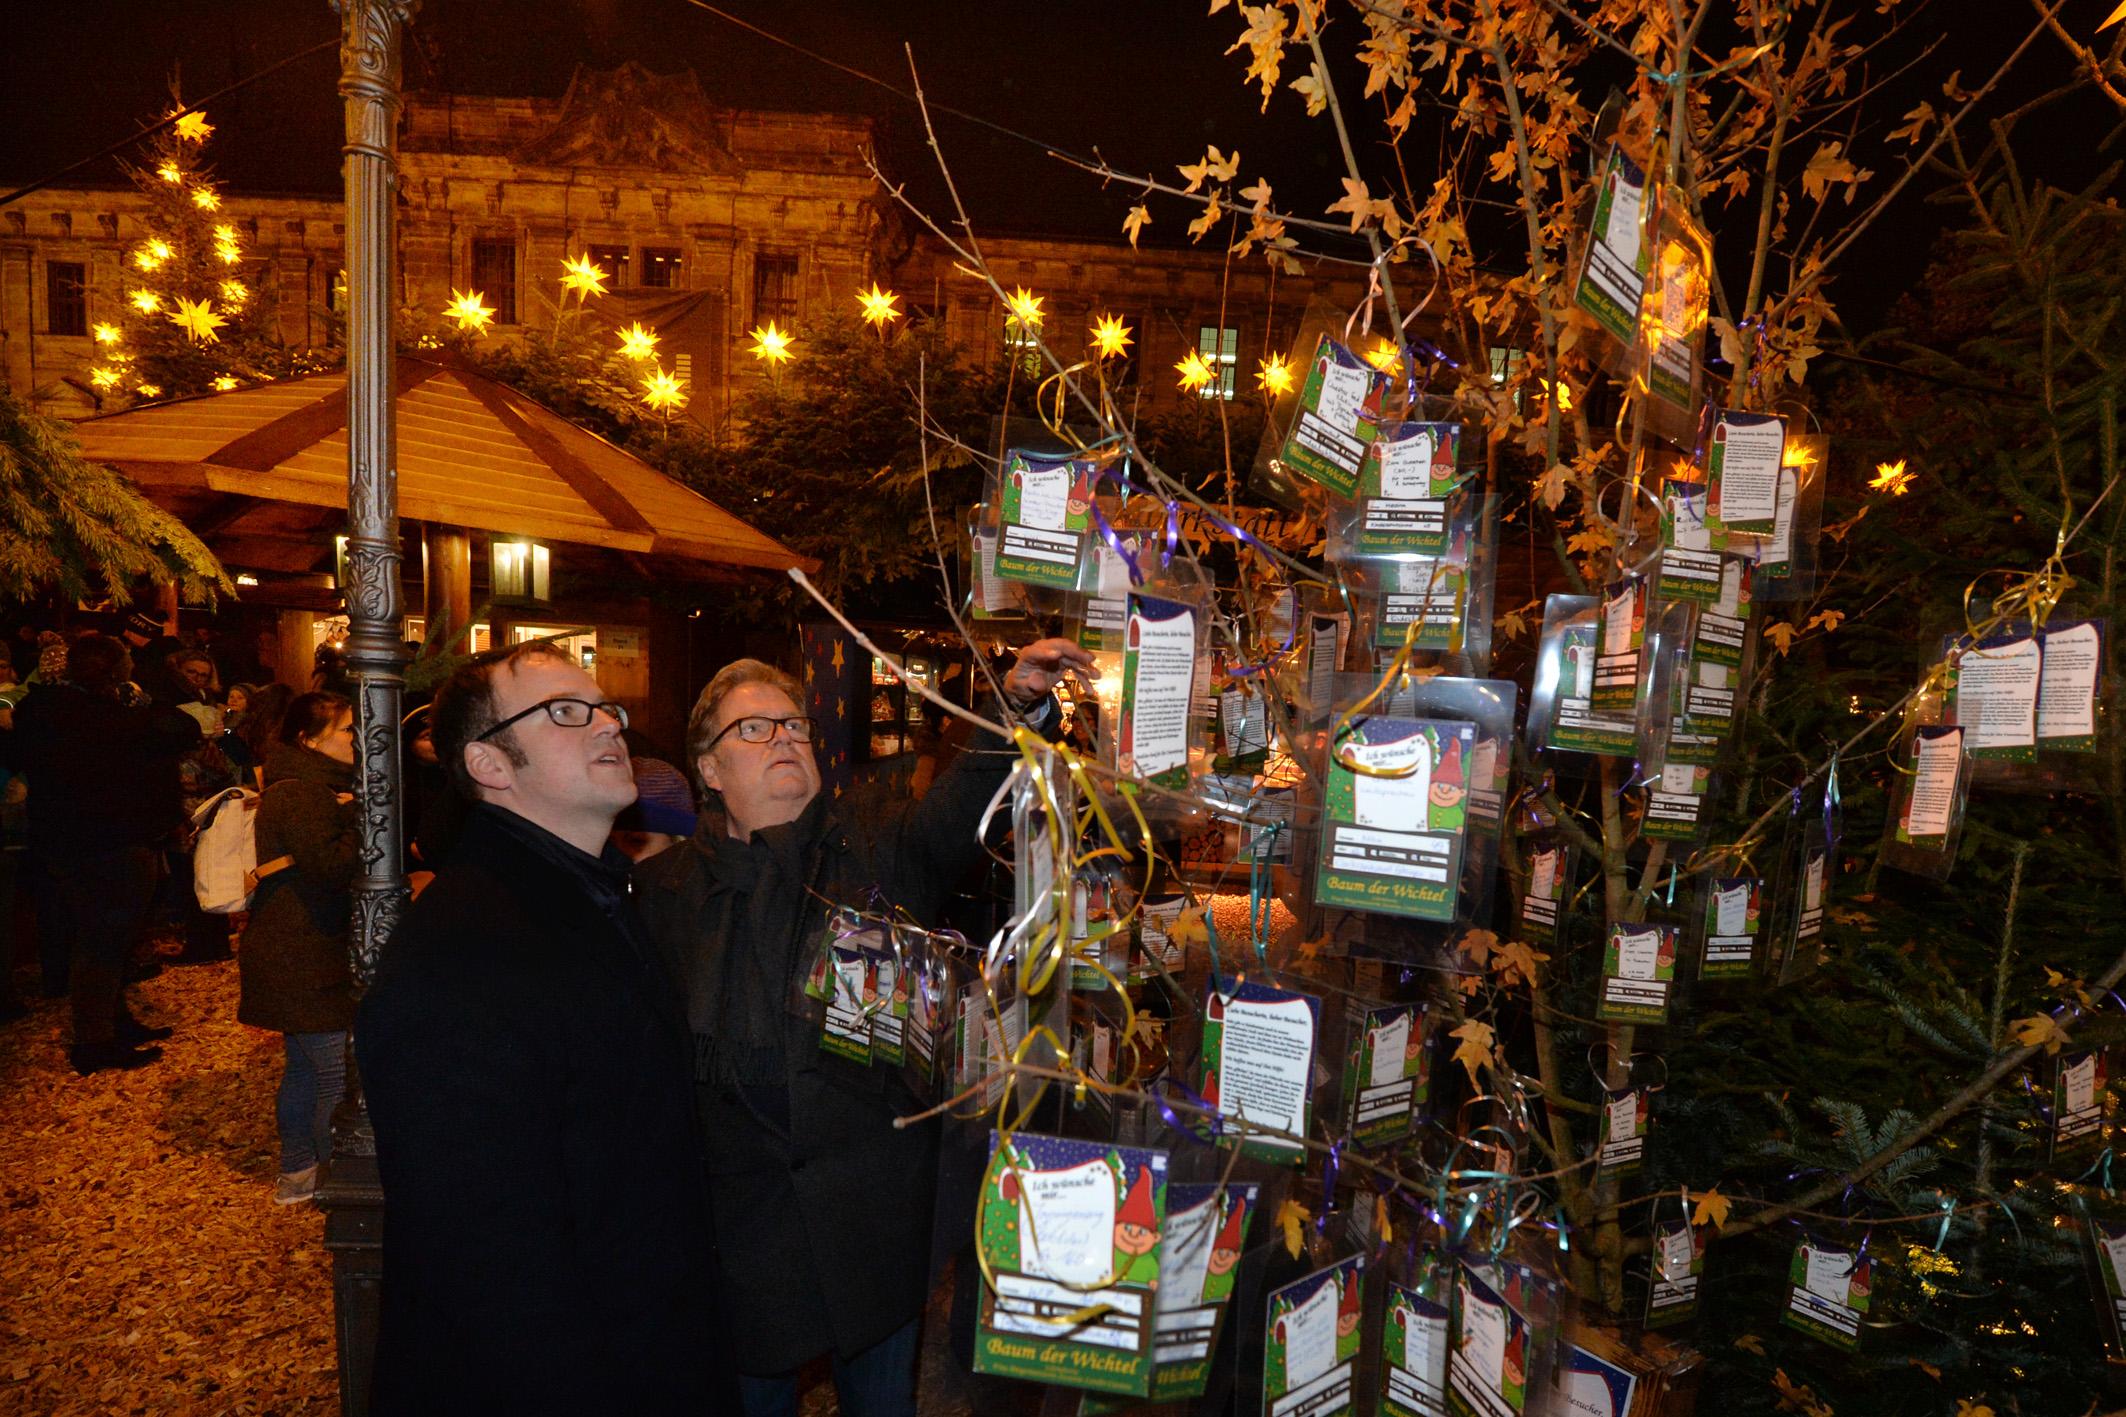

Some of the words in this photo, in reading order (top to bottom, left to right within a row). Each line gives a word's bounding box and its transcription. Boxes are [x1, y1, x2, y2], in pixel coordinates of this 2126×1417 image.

[1362, 534, 1388, 545] Baum
[1391, 534, 1405, 545] der
[1406, 535, 1443, 547] Wichtel
[1000, 558, 1025, 571] Baum
[1025, 561, 1039, 573] der
[1042, 564, 1077, 578] Wichtel
[1367, 750, 1379, 761] Ich
[1381, 748, 1415, 759] wünsche
[1327, 876, 1365, 892] Baum
[1368, 878, 1390, 895] der
[1393, 880, 1449, 902] Wichtel
[1033, 1177, 1048, 1191] Ich
[1052, 1177, 1096, 1189] wünsche
[986, 1337, 1036, 1361] Baum
[1040, 1342, 1066, 1364] der
[1068, 1346, 1142, 1376] Wichtel
